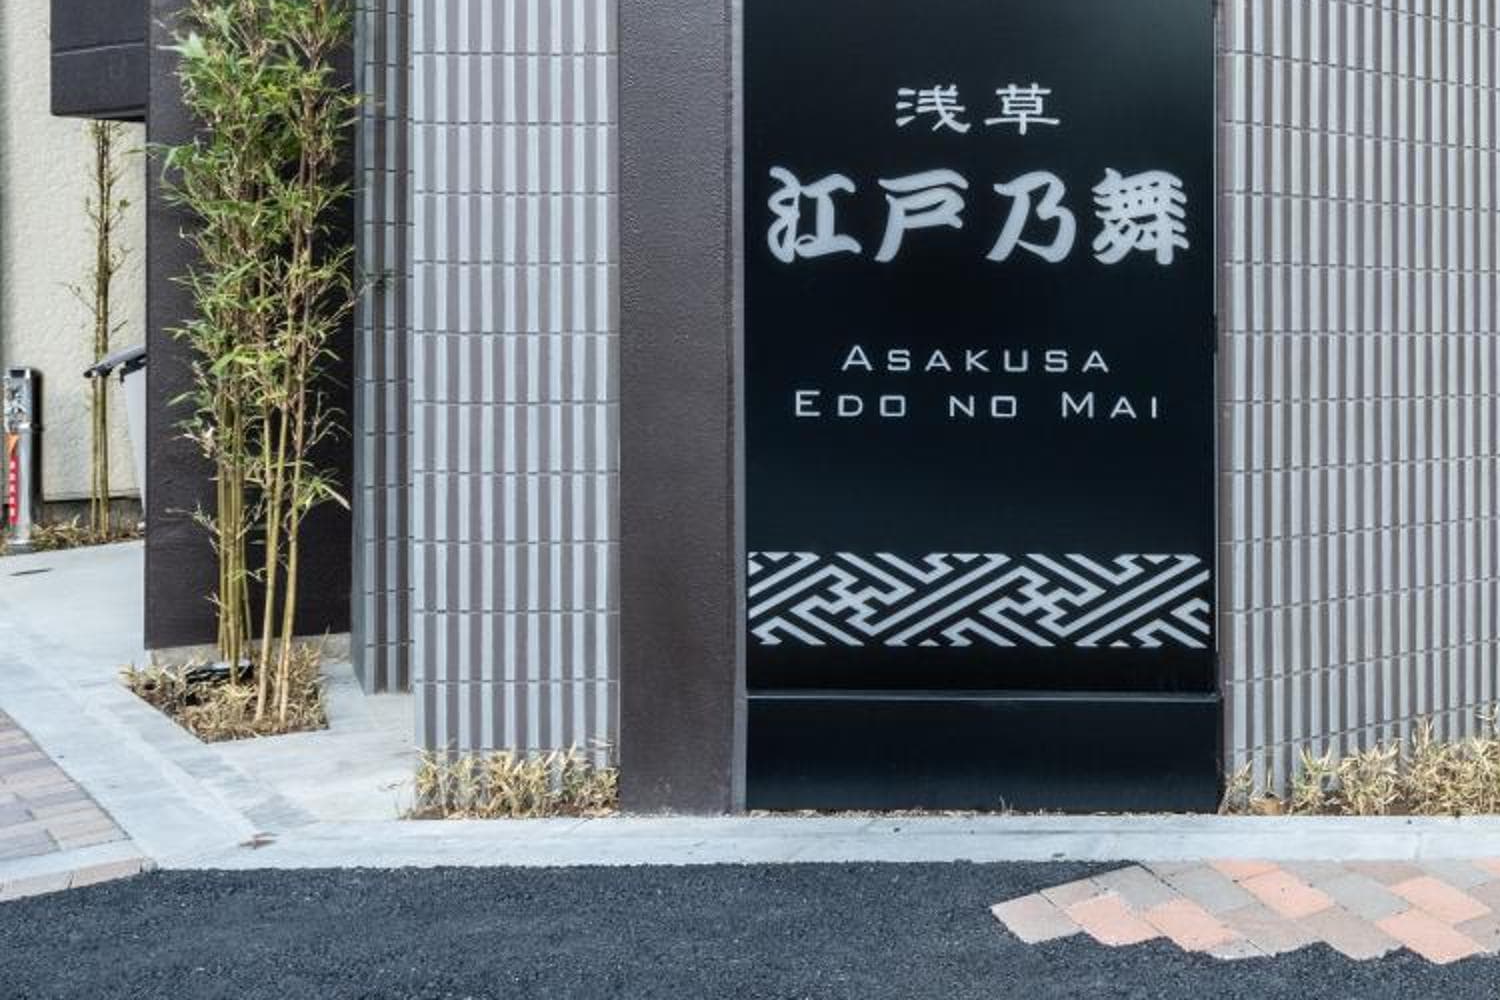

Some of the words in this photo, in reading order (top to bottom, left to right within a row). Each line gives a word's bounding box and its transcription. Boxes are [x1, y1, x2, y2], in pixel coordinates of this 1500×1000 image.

[895, 83, 1060, 135] 浅草
[767, 166, 1190, 266] 江戸乃舞
[841, 345, 1109, 373] ASAKUSA
[795, 390, 906, 417] EDO
[949, 395, 1017, 418] NO
[1062, 391, 1157, 419] MAI
